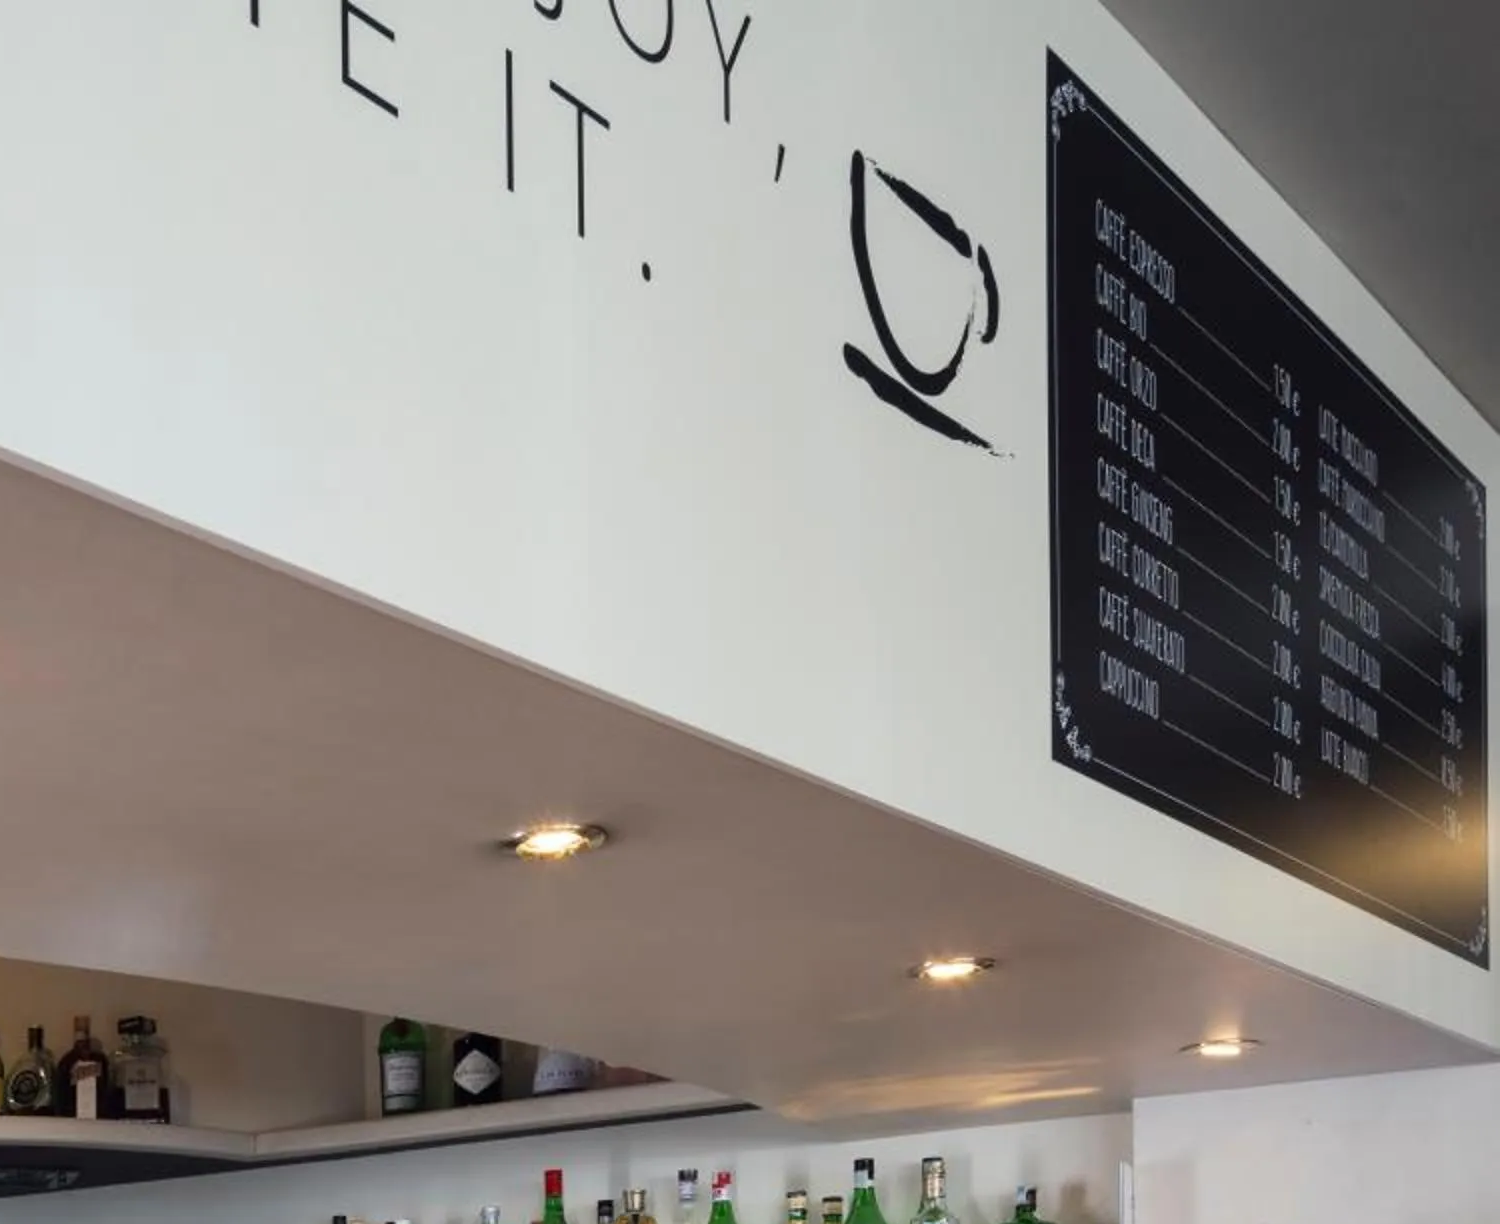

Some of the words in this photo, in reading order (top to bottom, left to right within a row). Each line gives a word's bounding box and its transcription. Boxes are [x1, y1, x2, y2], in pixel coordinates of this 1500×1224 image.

[505, 48, 651, 282] IT.
[1129, 292, 1147, 342] BIO
[1129, 355, 1157, 411] ORZO
[1131, 418, 1155, 471] DECA
